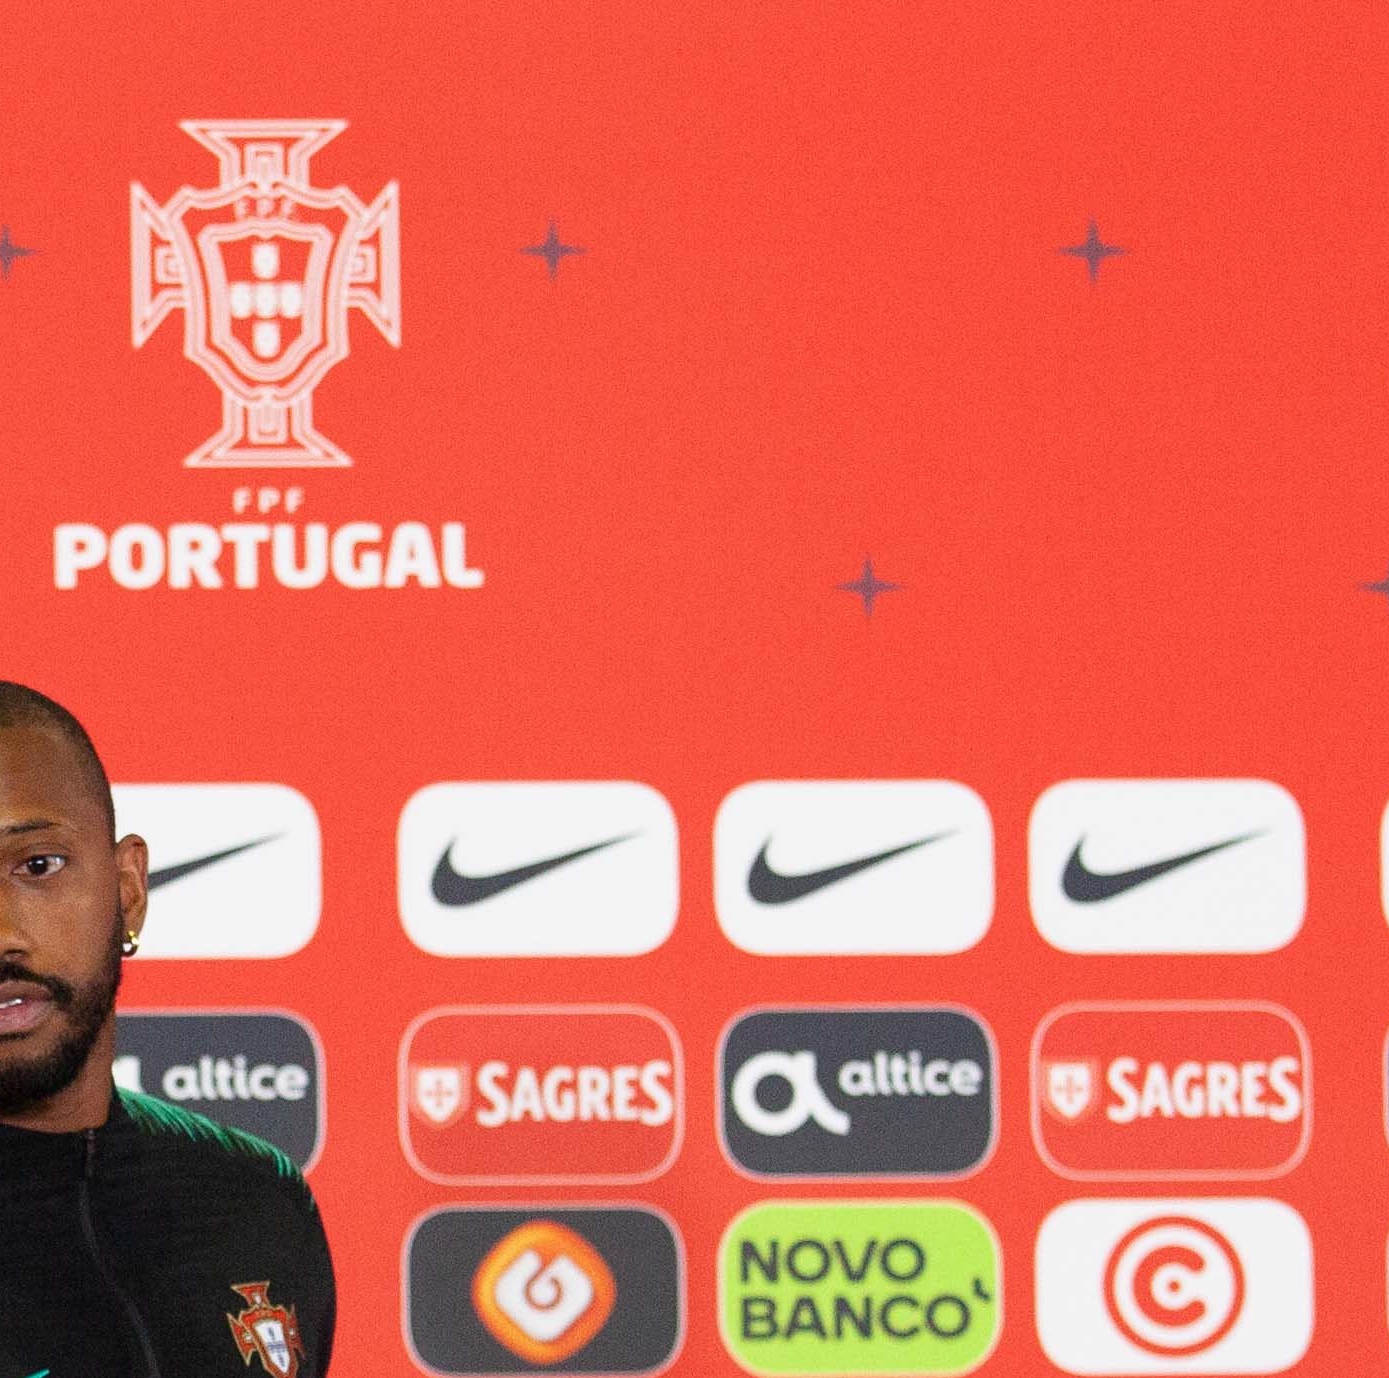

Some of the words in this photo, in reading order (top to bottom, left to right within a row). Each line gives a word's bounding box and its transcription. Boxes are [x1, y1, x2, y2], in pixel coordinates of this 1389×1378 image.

[233, 487, 302, 513] FPF
[54, 522, 485, 590] PORTUGAL
[162, 1054, 310, 1100] altice
[476, 1060, 673, 1128] SAGRES
[838, 1051, 983, 1096] altice
[1107, 1056, 1302, 1125] SAGRES
[739, 1237, 927, 1285] NOVO
[740, 1295, 972, 1342] BANCO
